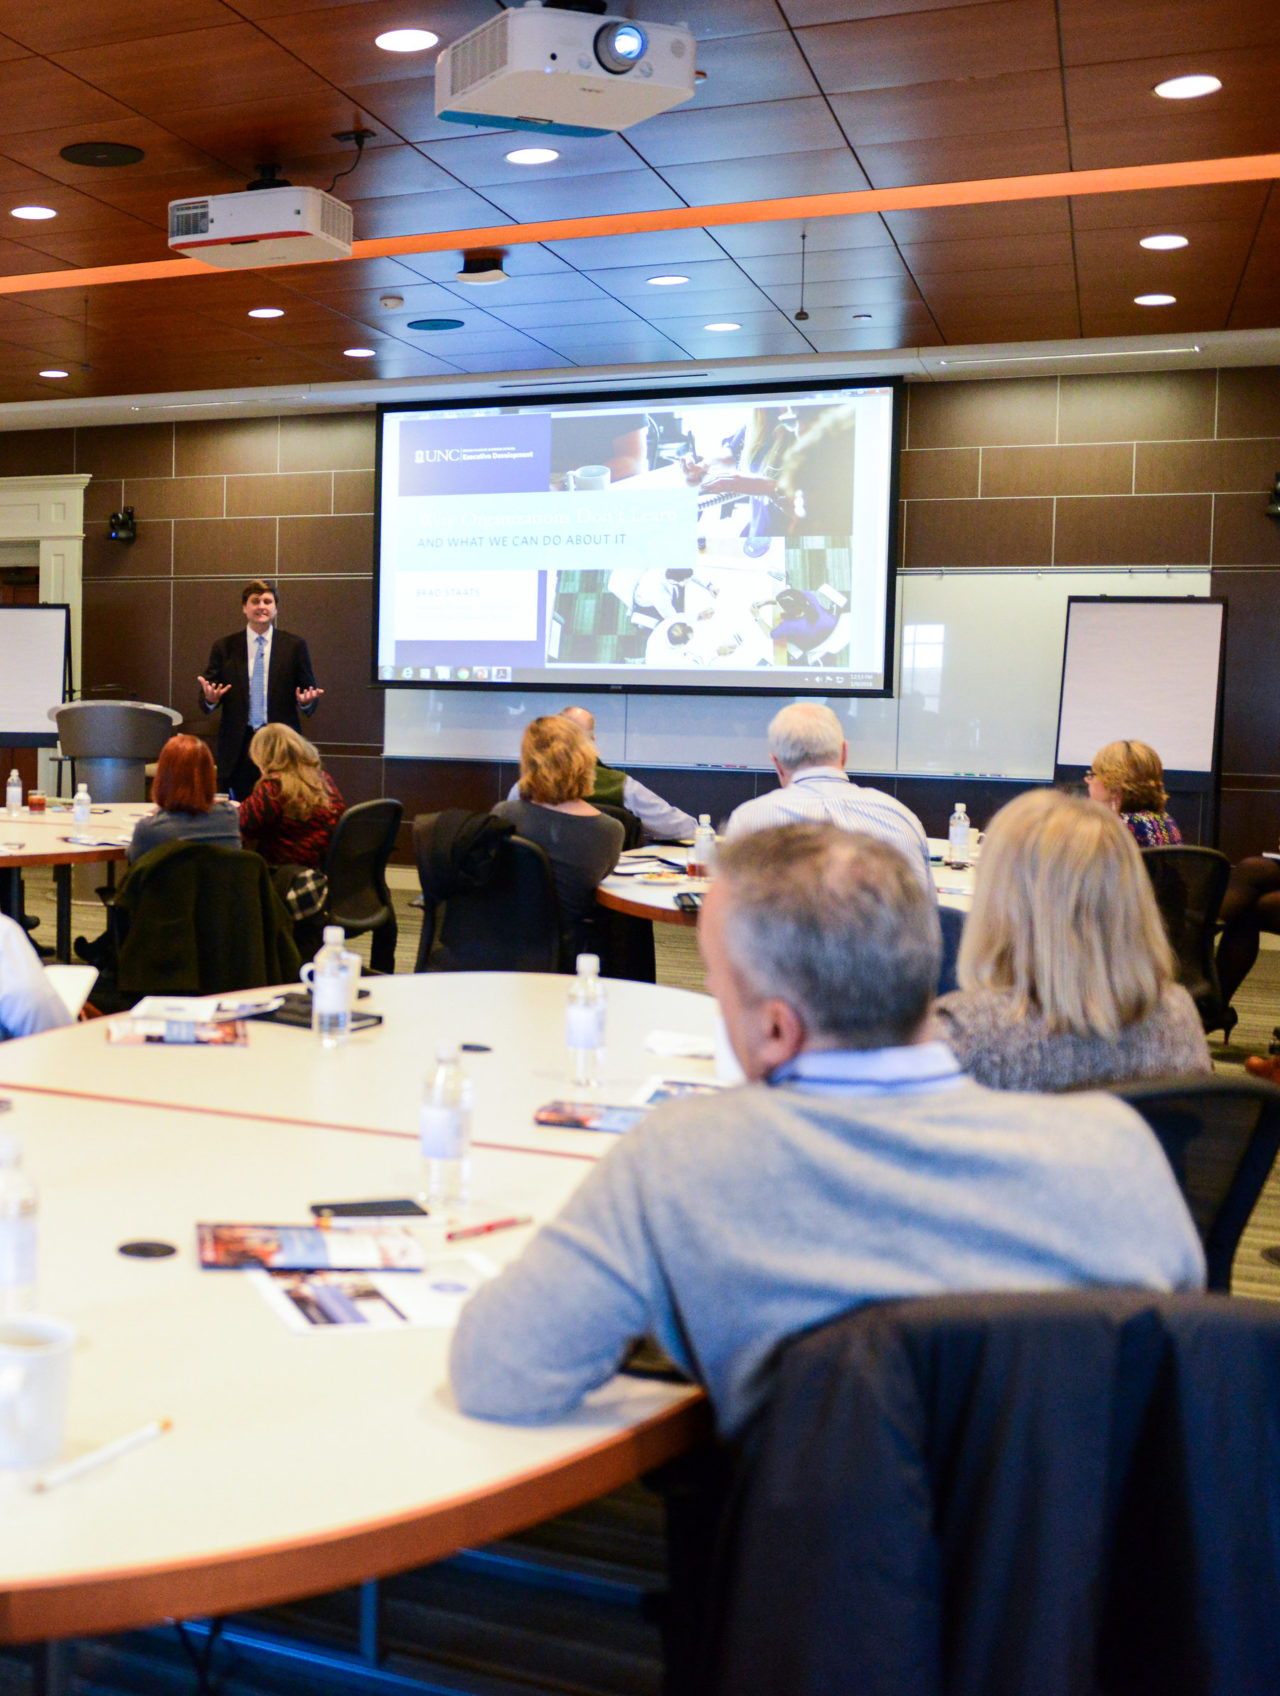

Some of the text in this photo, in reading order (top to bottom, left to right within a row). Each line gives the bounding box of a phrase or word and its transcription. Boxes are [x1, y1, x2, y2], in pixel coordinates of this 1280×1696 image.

[425, 448, 460, 463] UNC
[461, 508, 571, 530] Organizations
[576, 506, 624, 524] Don't
[631, 506, 678, 523] Learn
[417, 533, 627, 548] AND WHAT WE CAN DO ABOUT IT
